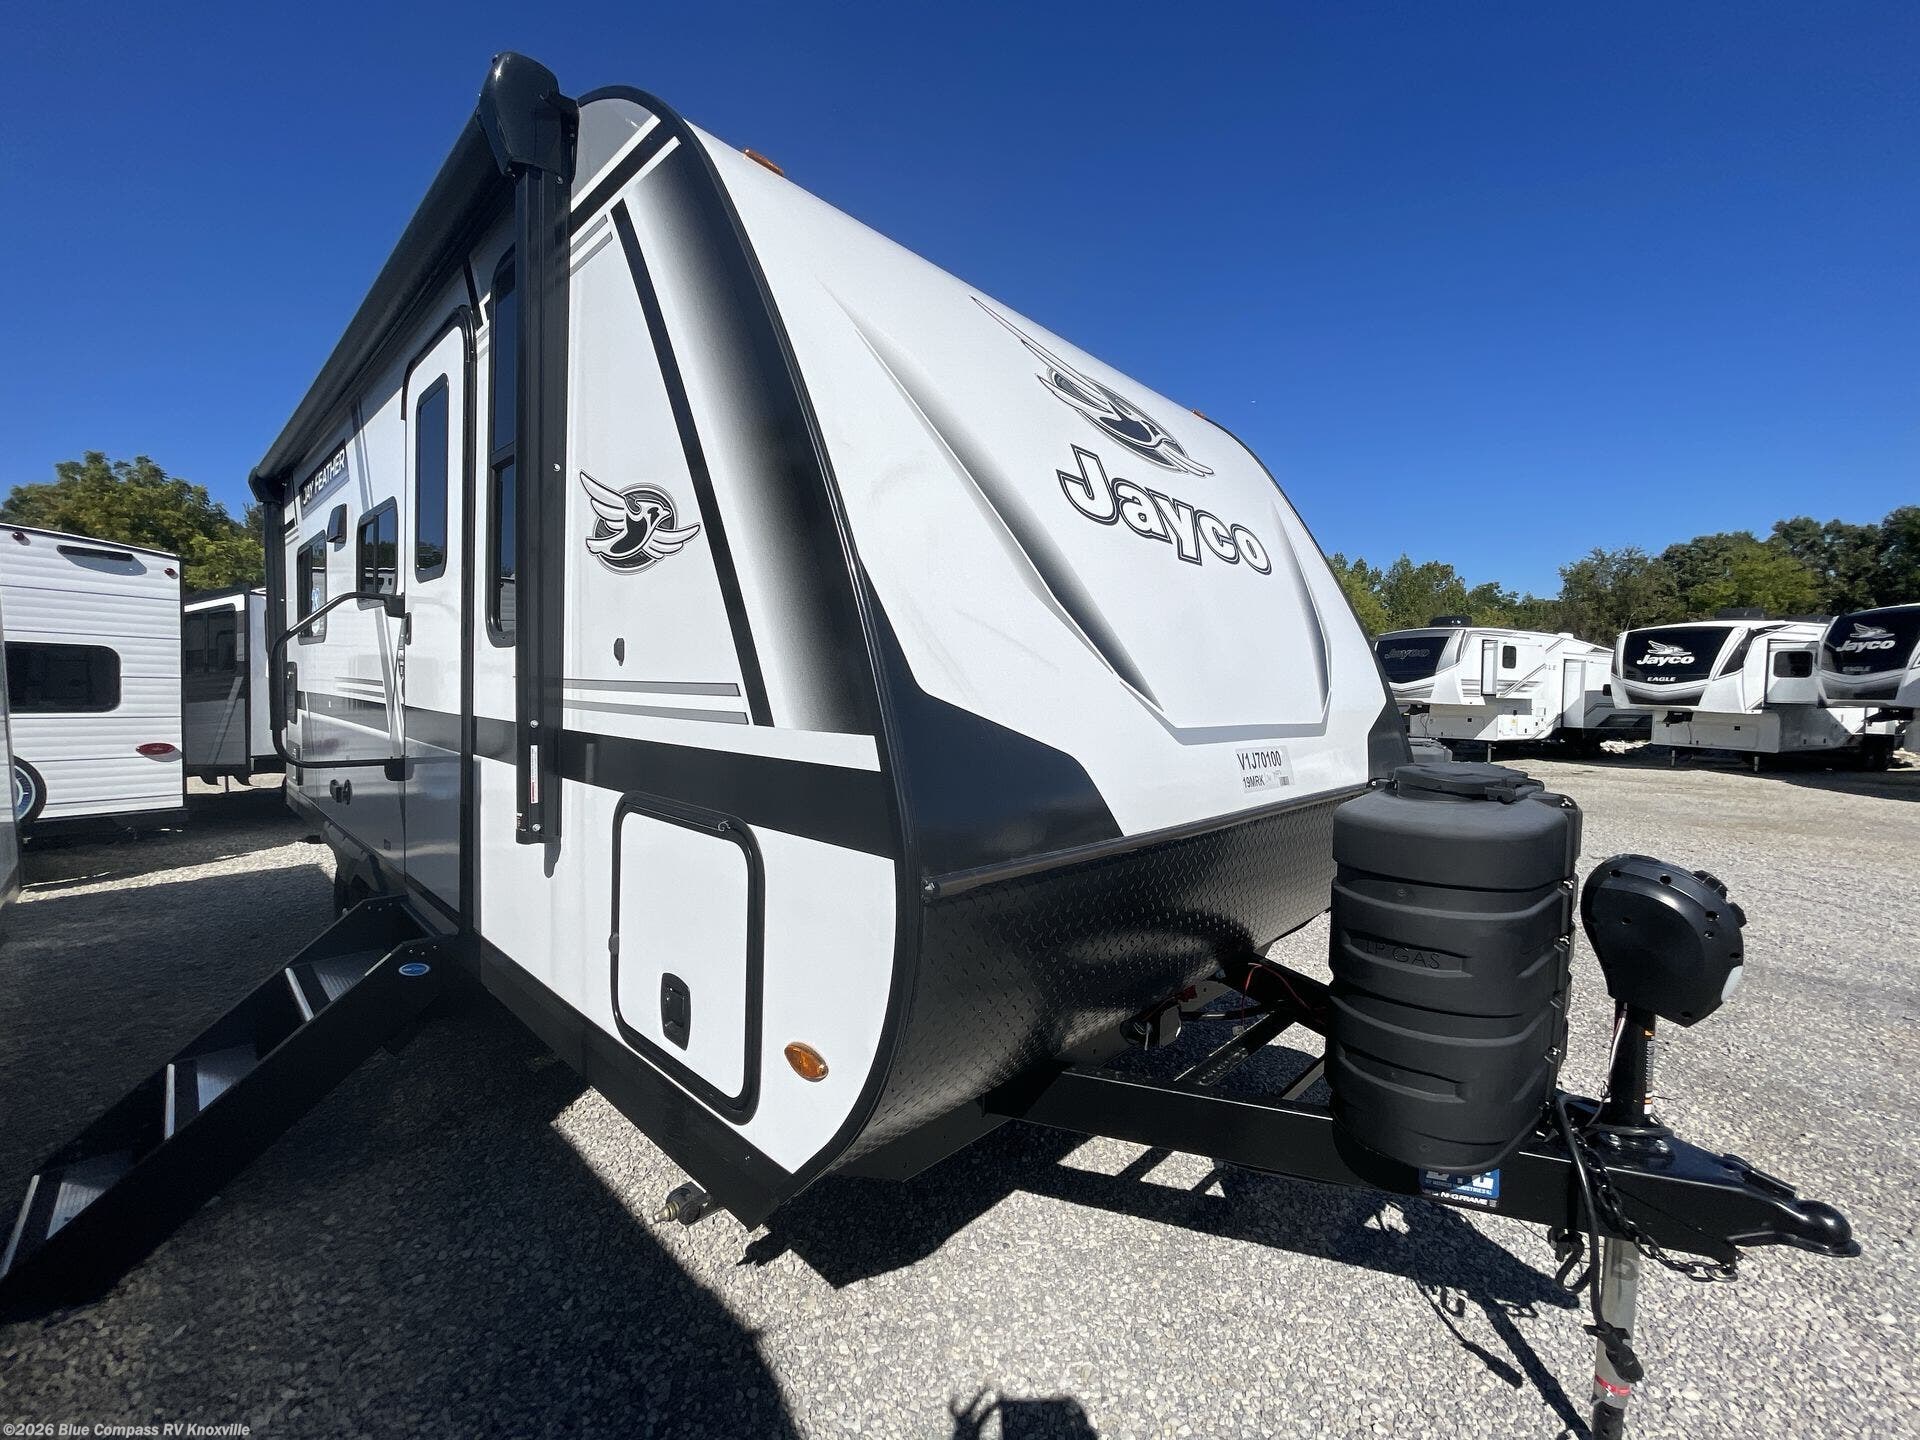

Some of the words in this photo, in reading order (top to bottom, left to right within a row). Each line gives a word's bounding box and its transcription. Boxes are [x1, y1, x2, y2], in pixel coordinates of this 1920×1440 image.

[303, 480, 314, 505] JAY
[314, 449, 345, 494] FEATHER
[1056, 443, 1273, 576] Jayco
[1384, 647, 1430, 660] Jayco
[1835, 639, 1896, 654] Jayco
[1636, 654, 1695, 667] Jayco
[1236, 750, 1282, 770] V1J70100
[1392, 946, 1440, 969] GAS
